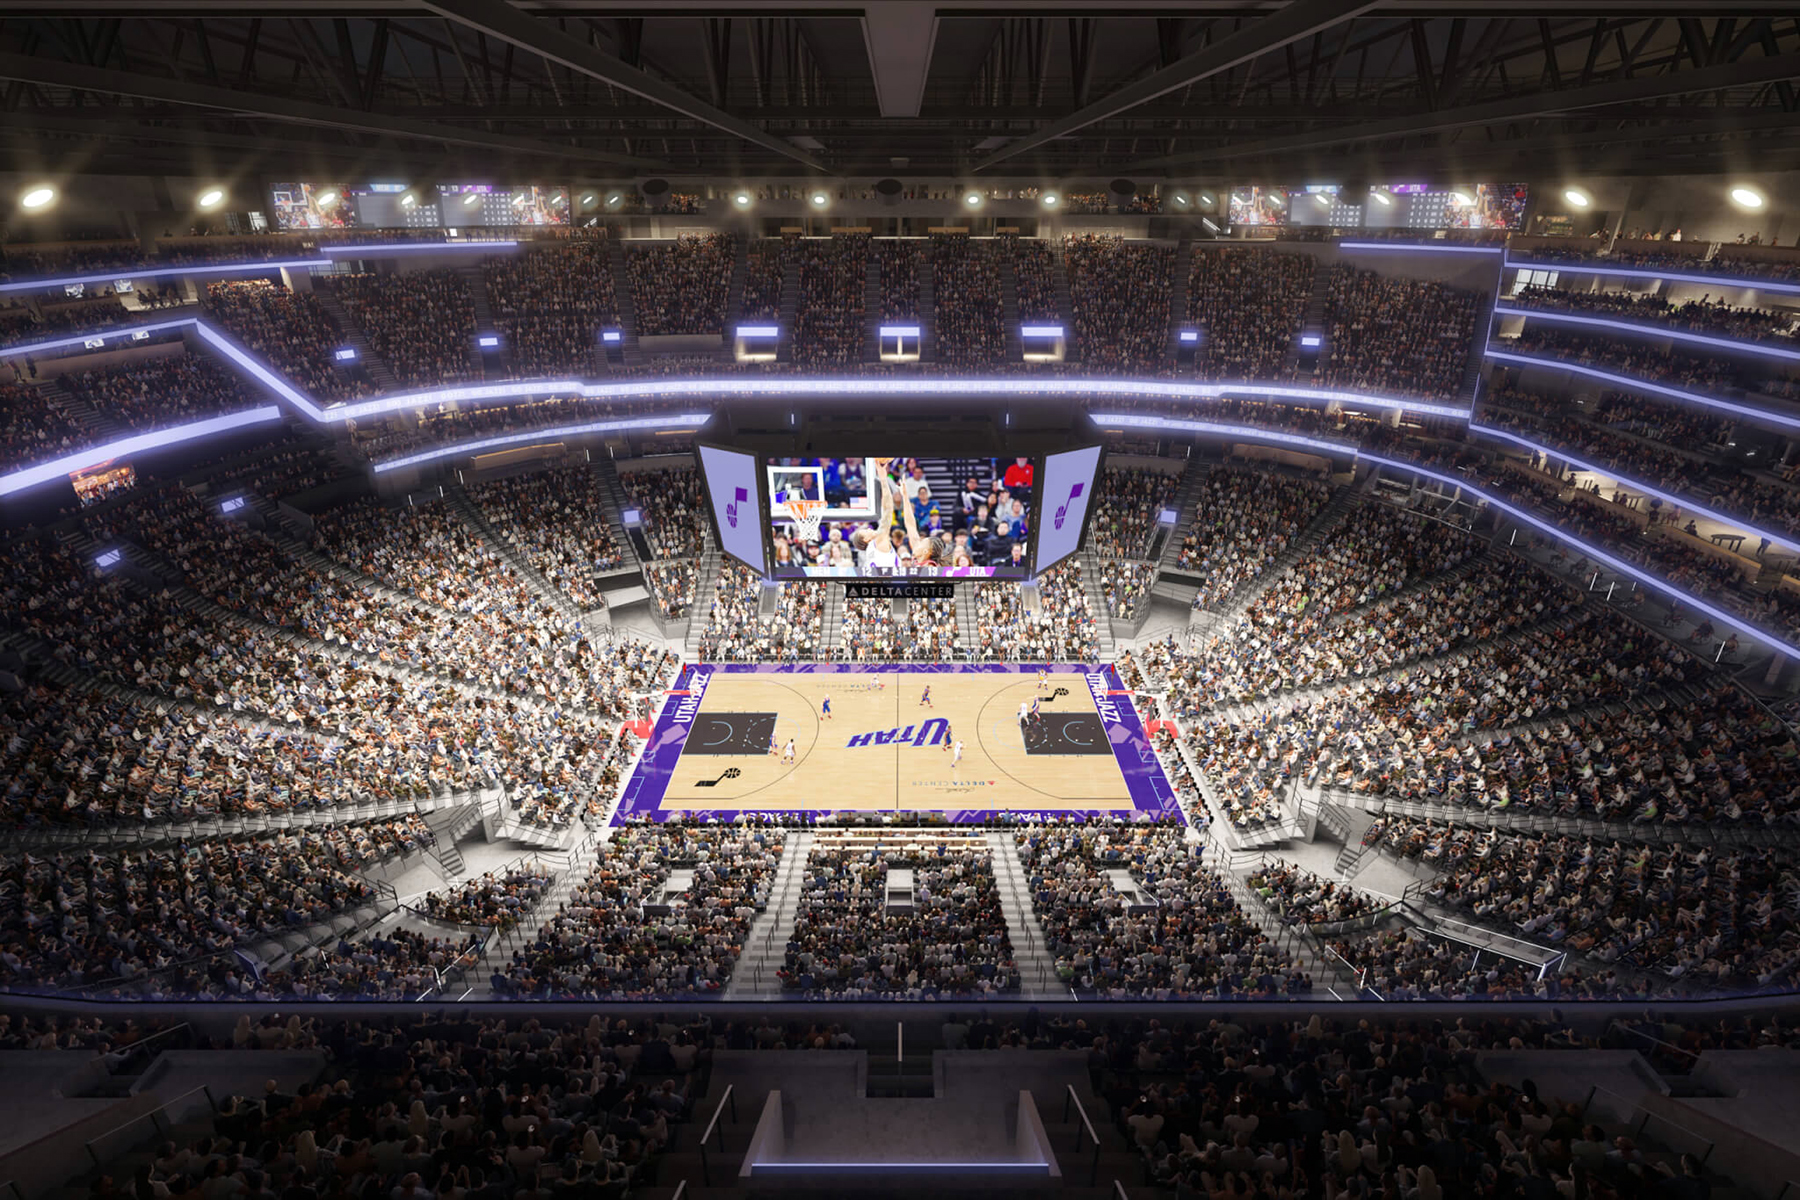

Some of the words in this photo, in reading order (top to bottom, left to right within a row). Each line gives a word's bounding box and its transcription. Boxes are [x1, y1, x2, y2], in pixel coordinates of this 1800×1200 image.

[862, 567, 872, 577] 12
[928, 566, 938, 577] 13
[861, 587, 902, 596] DELTA
[903, 587, 952, 596] CENTER
[671, 697, 700, 723] UTAH
[1095, 697, 1122, 723] JAZZ
[844, 717, 949, 748] UTAH
